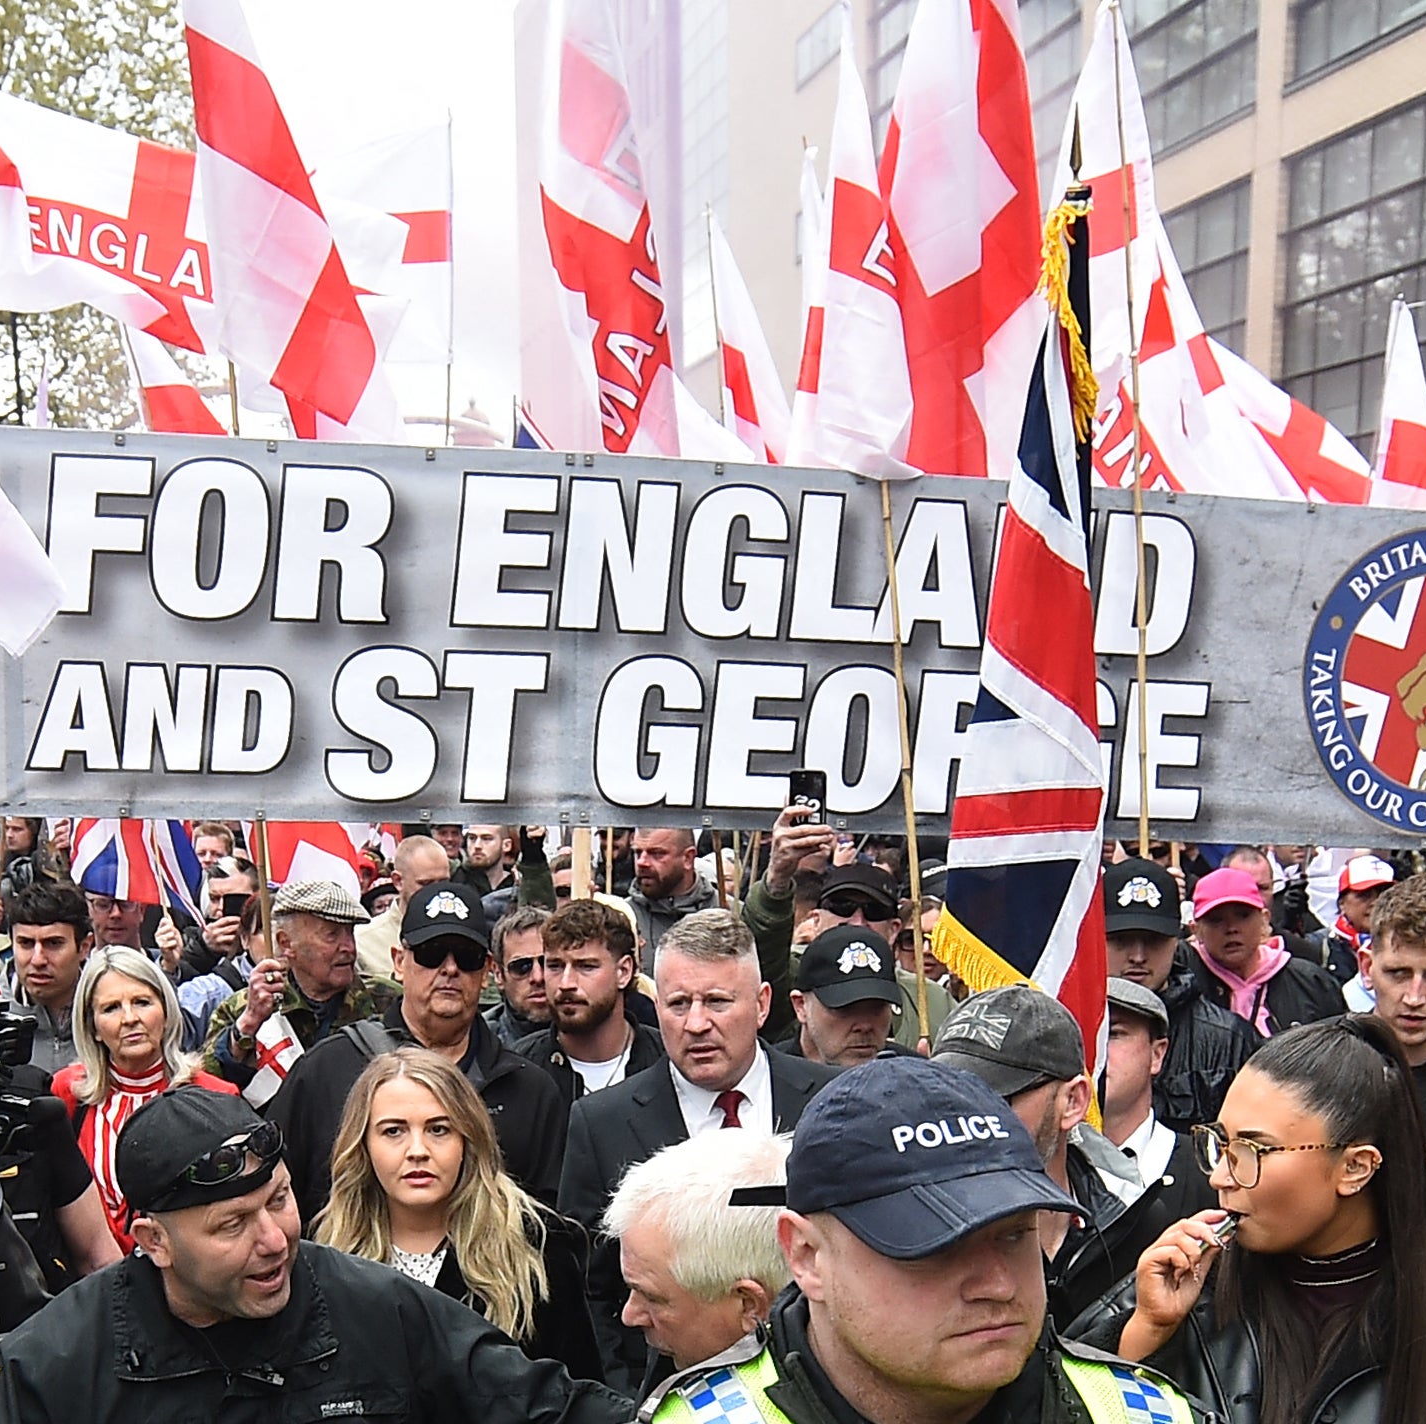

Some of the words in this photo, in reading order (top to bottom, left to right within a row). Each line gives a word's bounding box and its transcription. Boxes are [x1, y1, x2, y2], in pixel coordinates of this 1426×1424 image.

[48, 453, 394, 625] FOR
[450, 469, 1197, 658] ENGLAD
[25, 661, 295, 775] AND
[325, 645, 550, 804] ST
[594, 655, 1211, 821] GEORE
[1310, 647, 1354, 770] TAKING
[1347, 768, 1402, 822] OUR
[892, 1115, 1010, 1152] POLICE
